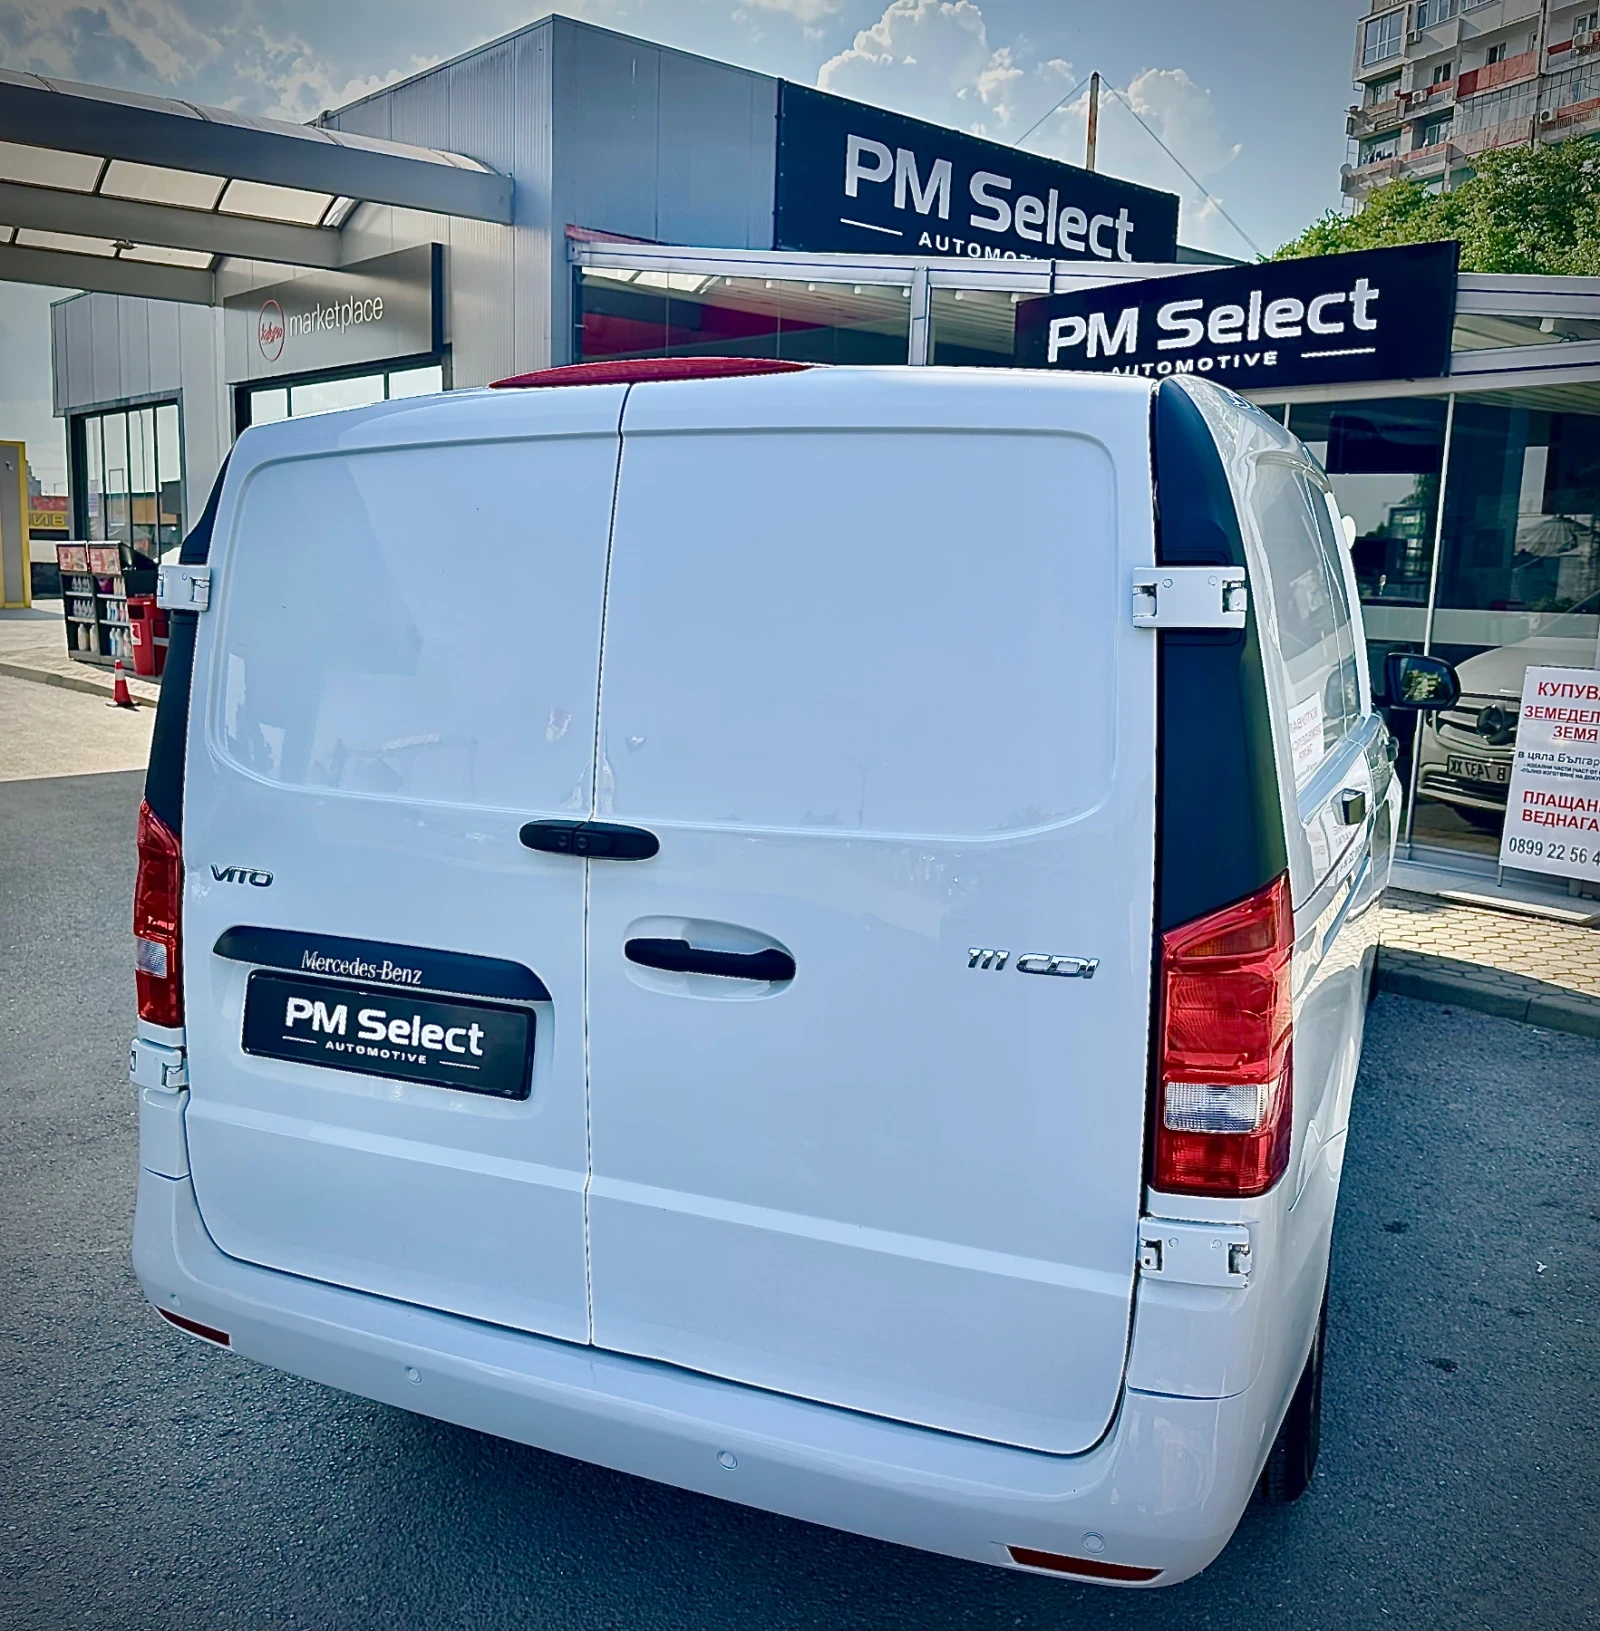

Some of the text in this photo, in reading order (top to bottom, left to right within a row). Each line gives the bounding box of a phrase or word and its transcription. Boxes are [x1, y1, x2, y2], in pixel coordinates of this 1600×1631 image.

[845, 133, 1134, 262] PM Select
[918, 231, 1056, 261] AUTOMO
[289, 294, 384, 337] marketplace
[1047, 278, 1380, 363] PM Select
[1538, 681, 1600, 700] КУПУВ
[1524, 705, 1600, 724] ЗЕМЕДЕЛ
[1553, 725, 1598, 741] ЗЕМЯ
[1527, 751, 1555, 761] цяла
[1523, 790, 1600, 813] ПЛАЩАН
[1522, 808, 1600, 832] ВЕДНАГА
[1509, 836, 1543, 857] 0899
[1547, 843, 1566, 860] 22
[1569, 846, 1588, 864] 56
[210, 863, 274, 887] VITO
[301, 950, 423, 985] Mercedes-Benz
[967, 947, 1100, 979] 111 CDI
[285, 996, 485, 1057] PM Select
[324, 1040, 427, 1065] AUTOMOTIVE
